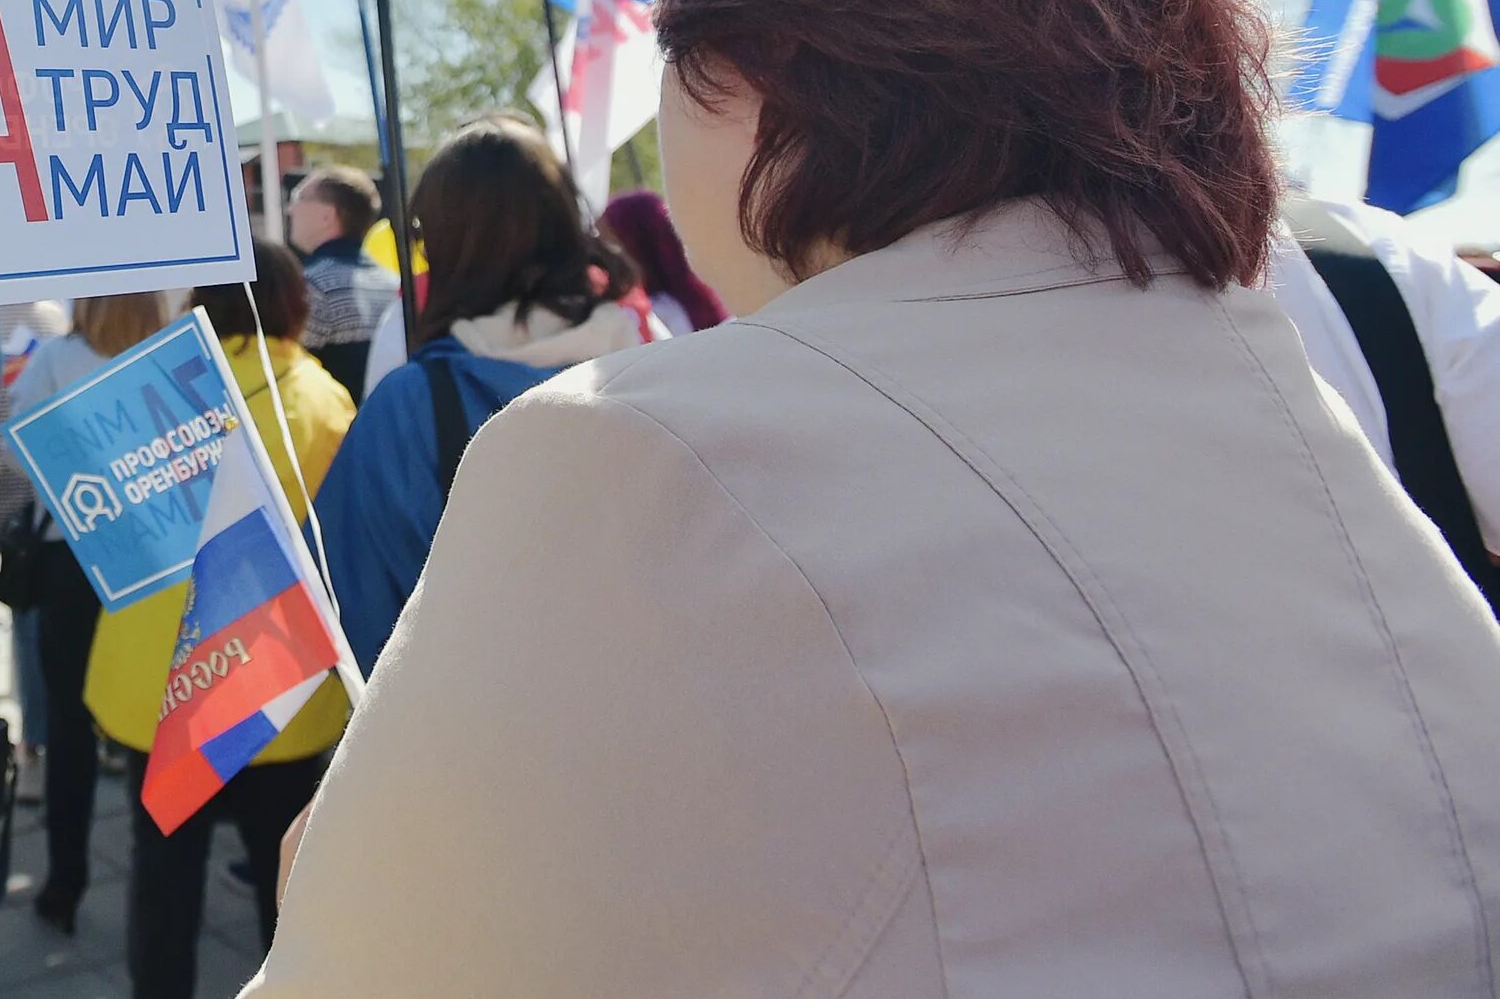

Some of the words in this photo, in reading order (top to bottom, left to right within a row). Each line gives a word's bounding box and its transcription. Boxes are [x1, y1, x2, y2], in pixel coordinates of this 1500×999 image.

[35, 68, 213, 144] ТРУД
[48, 139, 206, 221] МАЙ
[124, 438, 225, 504] ОРЕНБУРЖ
